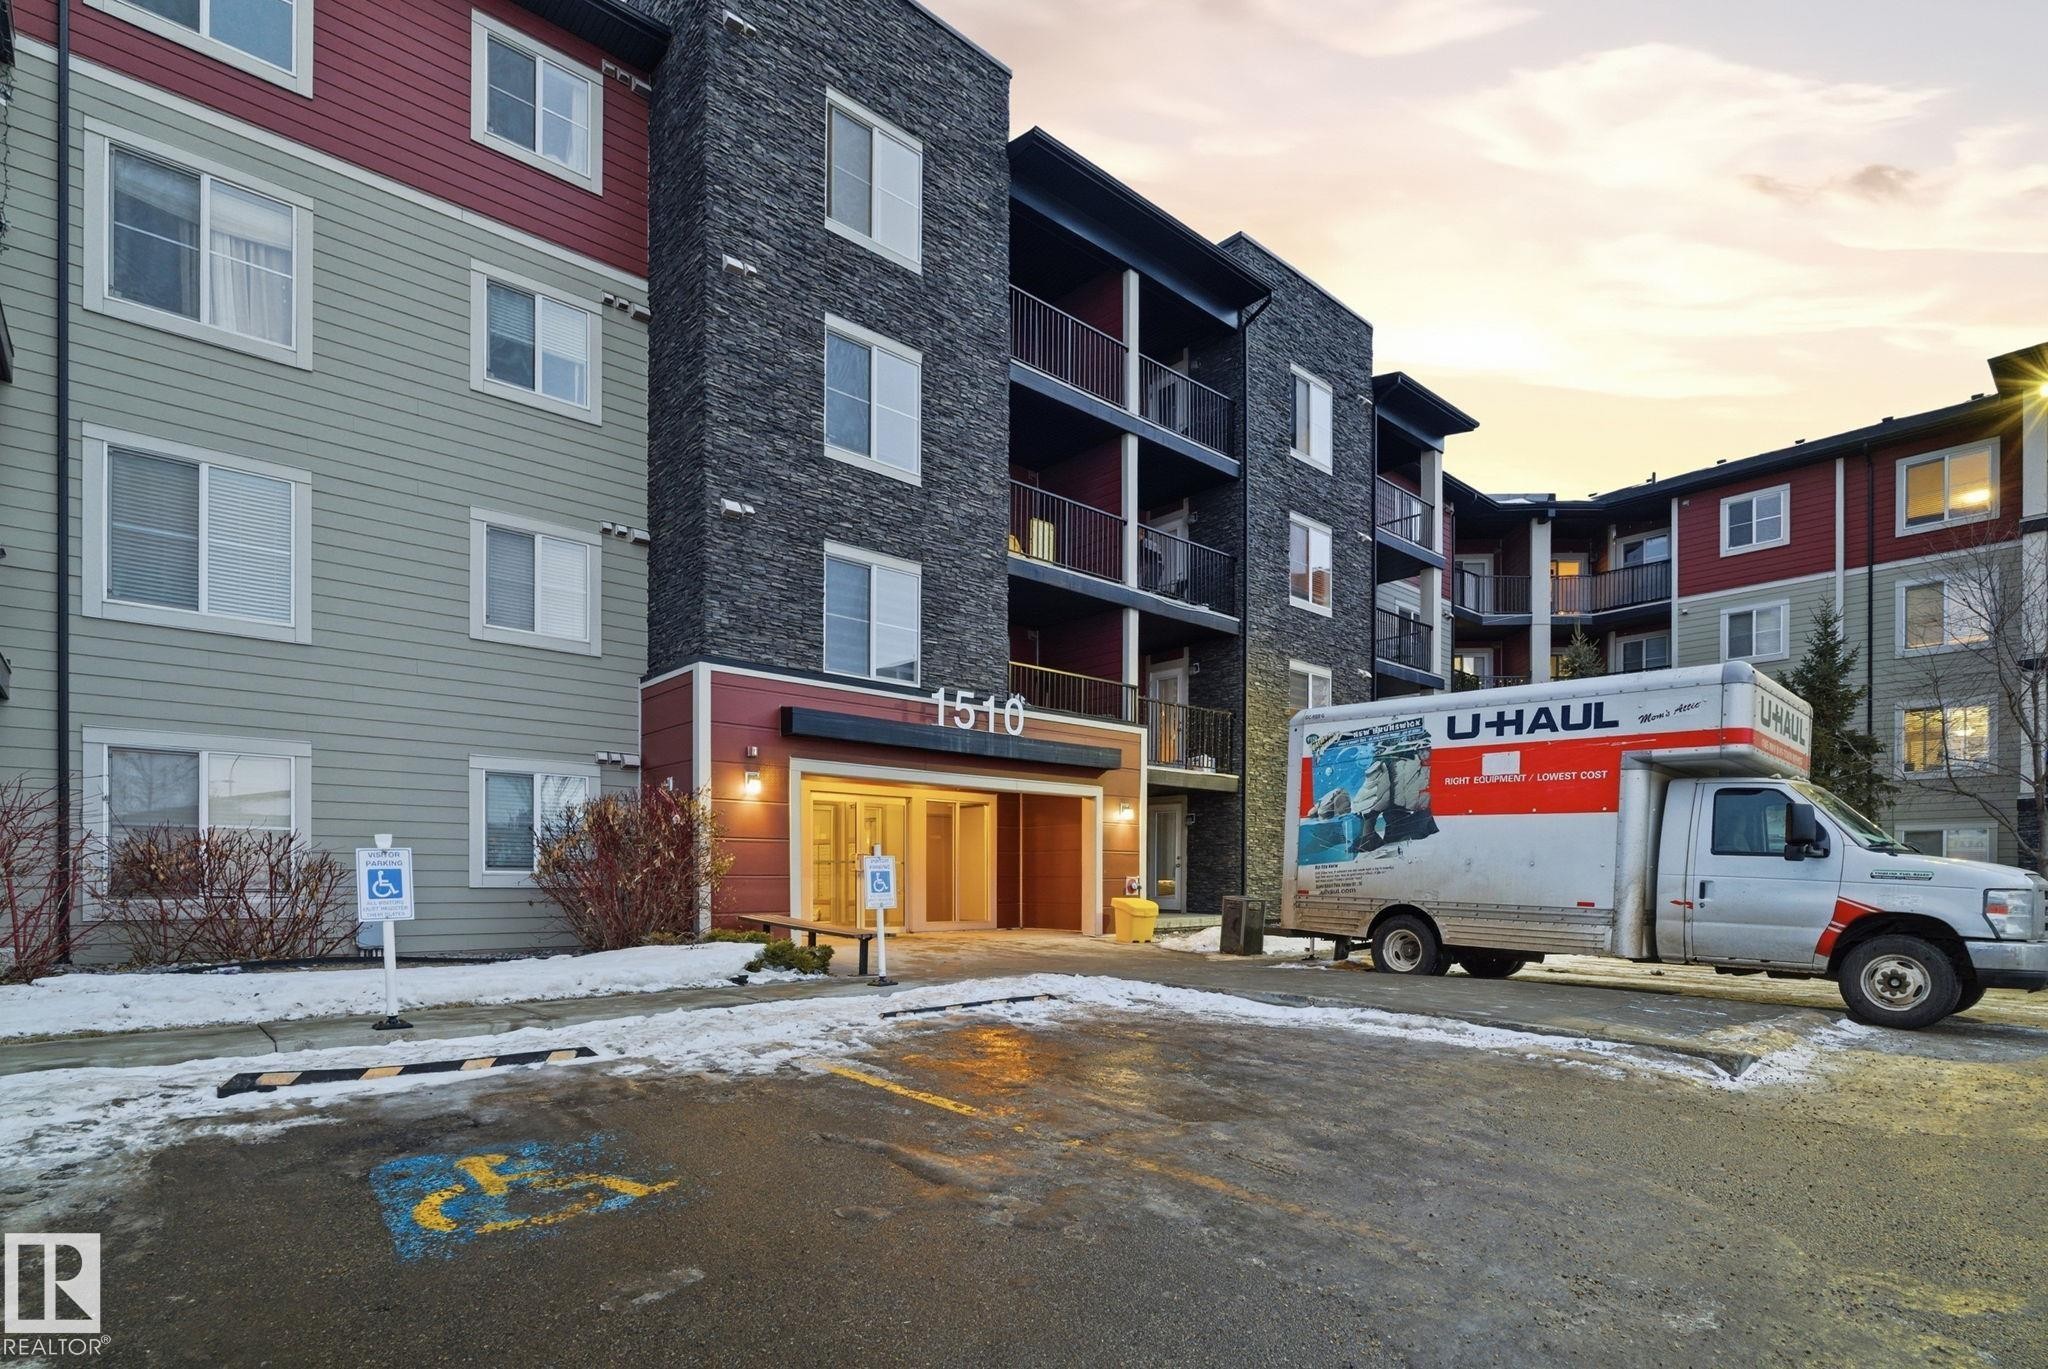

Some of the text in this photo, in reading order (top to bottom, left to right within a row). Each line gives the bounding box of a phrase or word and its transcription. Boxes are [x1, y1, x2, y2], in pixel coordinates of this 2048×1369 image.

[932, 687, 1024, 736] 1510
[1447, 701, 1620, 741] U-HAUL
[1638, 701, 1701, 724] Mom's Attic
[1761, 695, 1806, 746] U-HAUL
[1444, 776, 1470, 785] RIGHT
[1473, 773, 1527, 785] EQUIPMENT
[1537, 771, 1578, 782] LOWEST
[1580, 770, 1608, 780] COST
